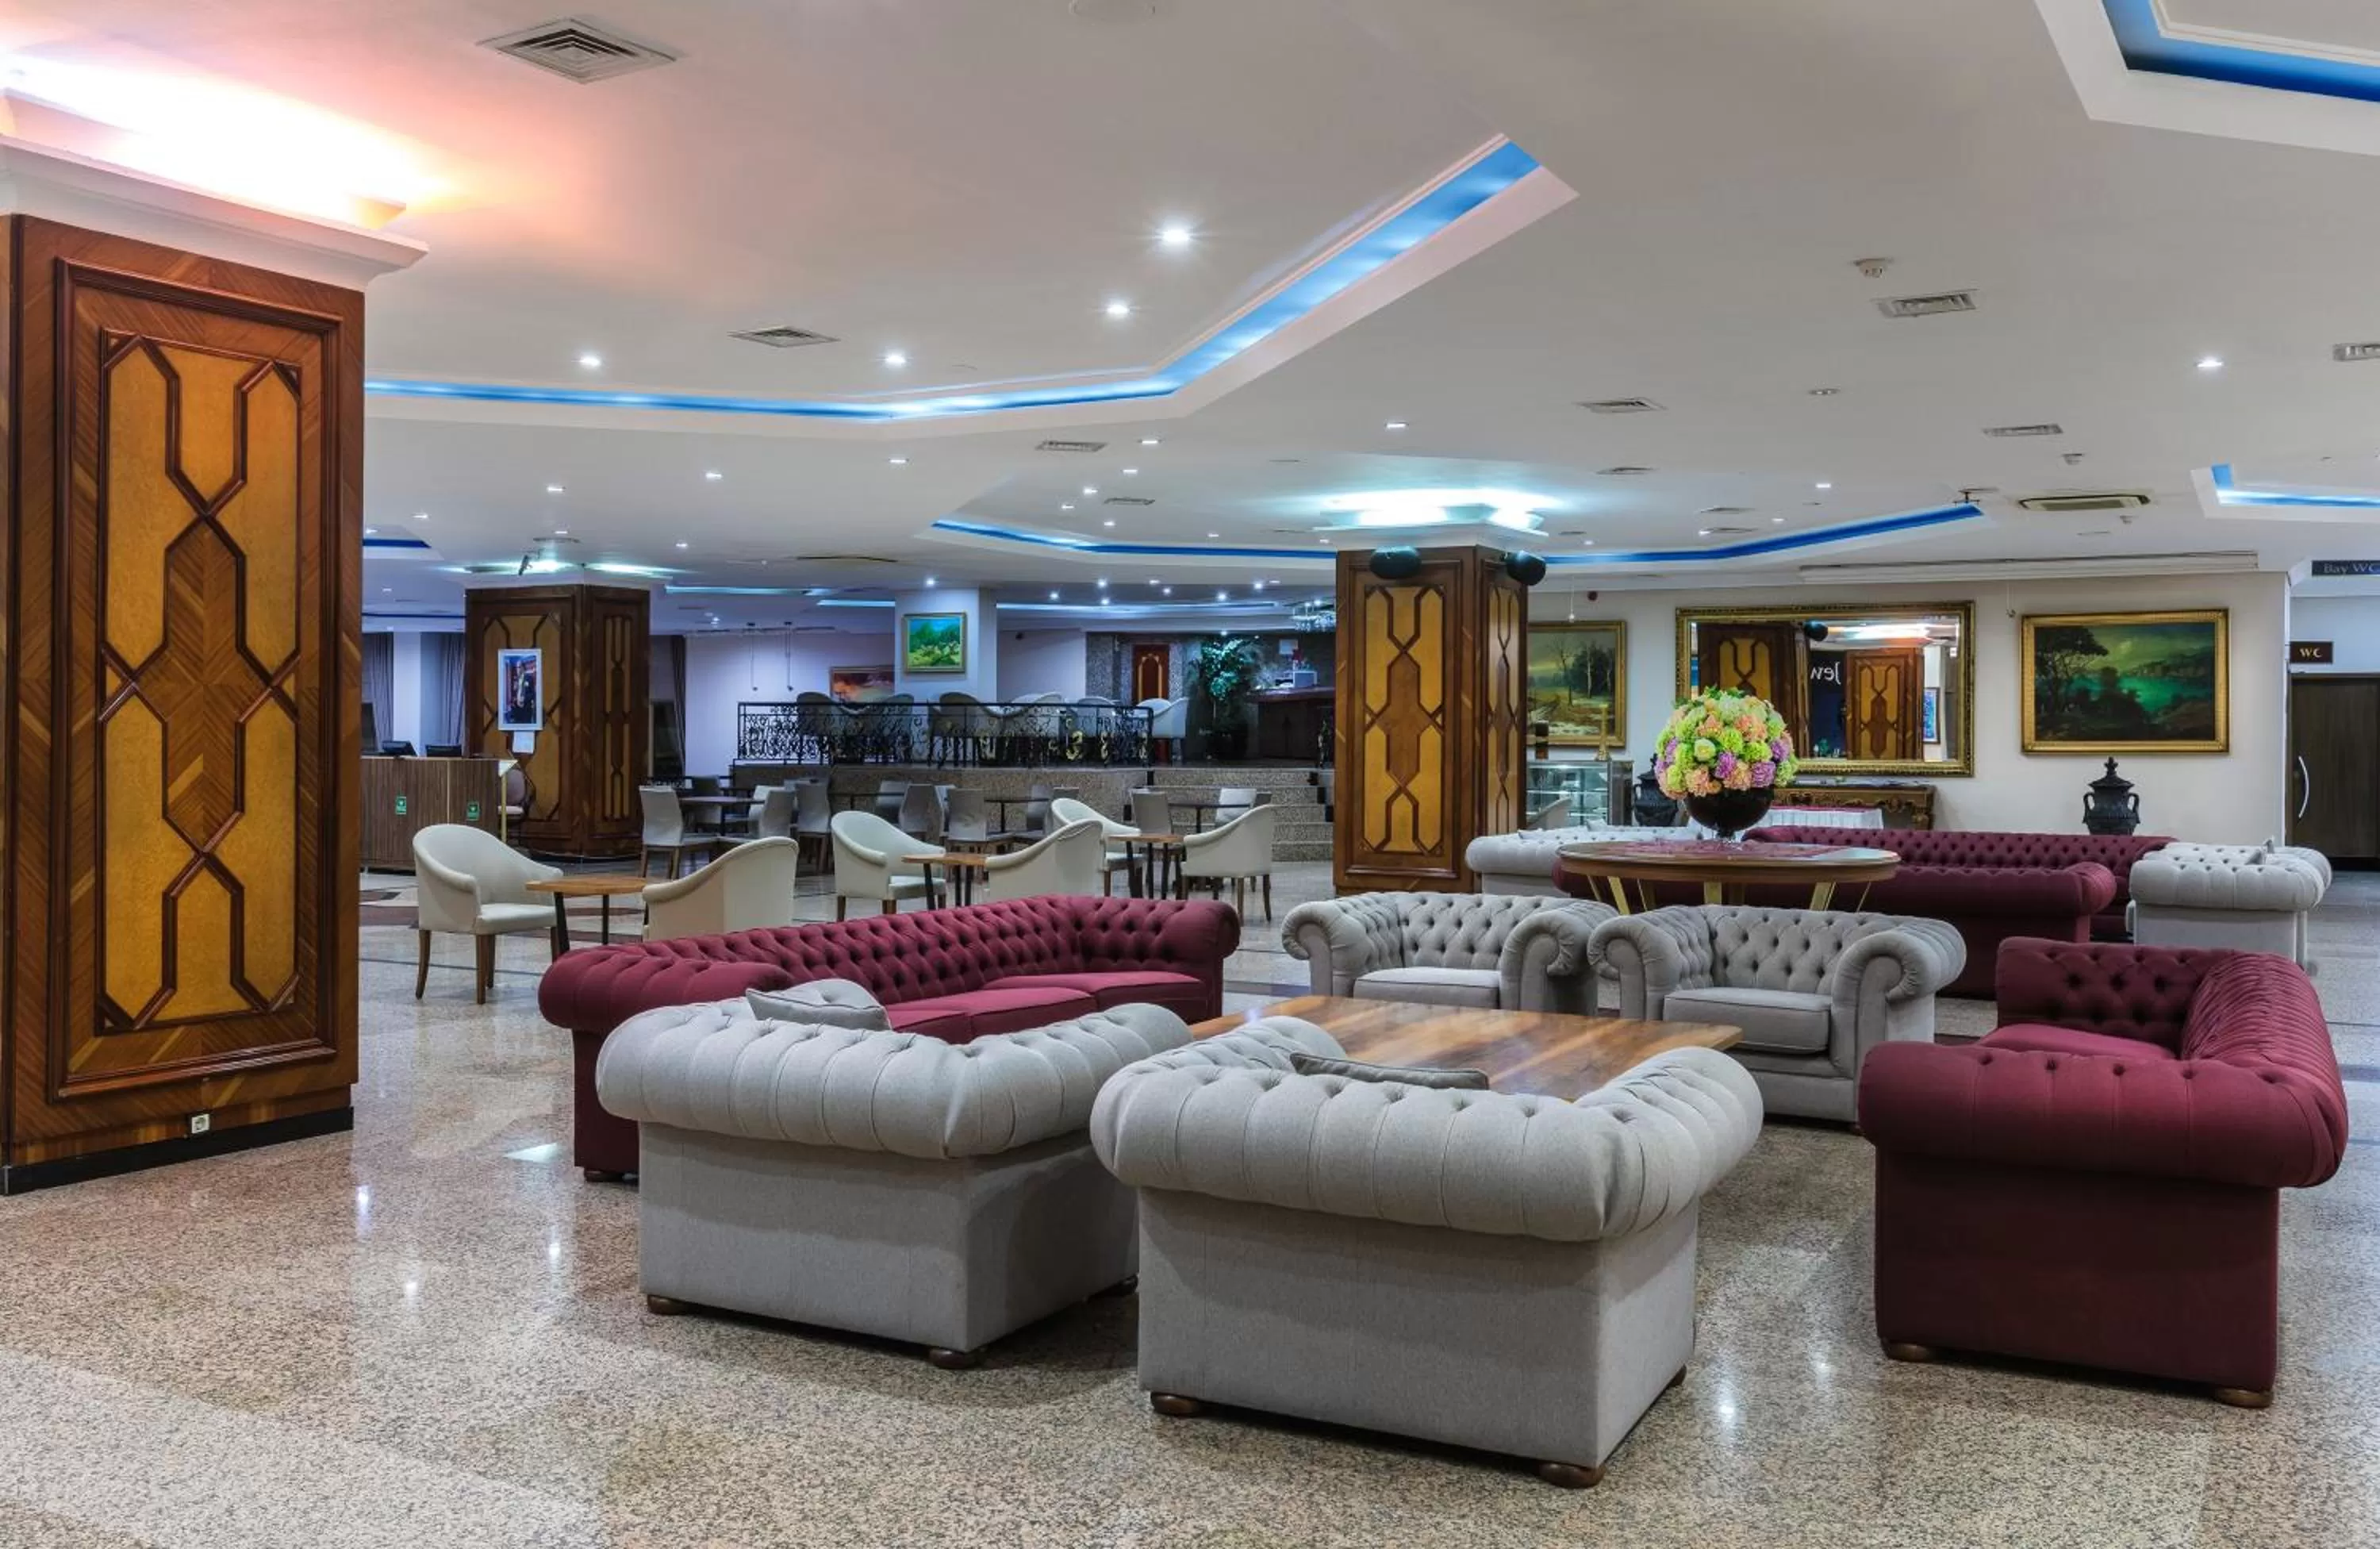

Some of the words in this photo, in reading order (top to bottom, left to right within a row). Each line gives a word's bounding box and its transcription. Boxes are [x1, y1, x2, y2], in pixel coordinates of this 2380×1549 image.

[2324, 563, 2348, 575] Bay
[2352, 563, 2375, 572] WC
[2300, 648, 2322, 658] WC
